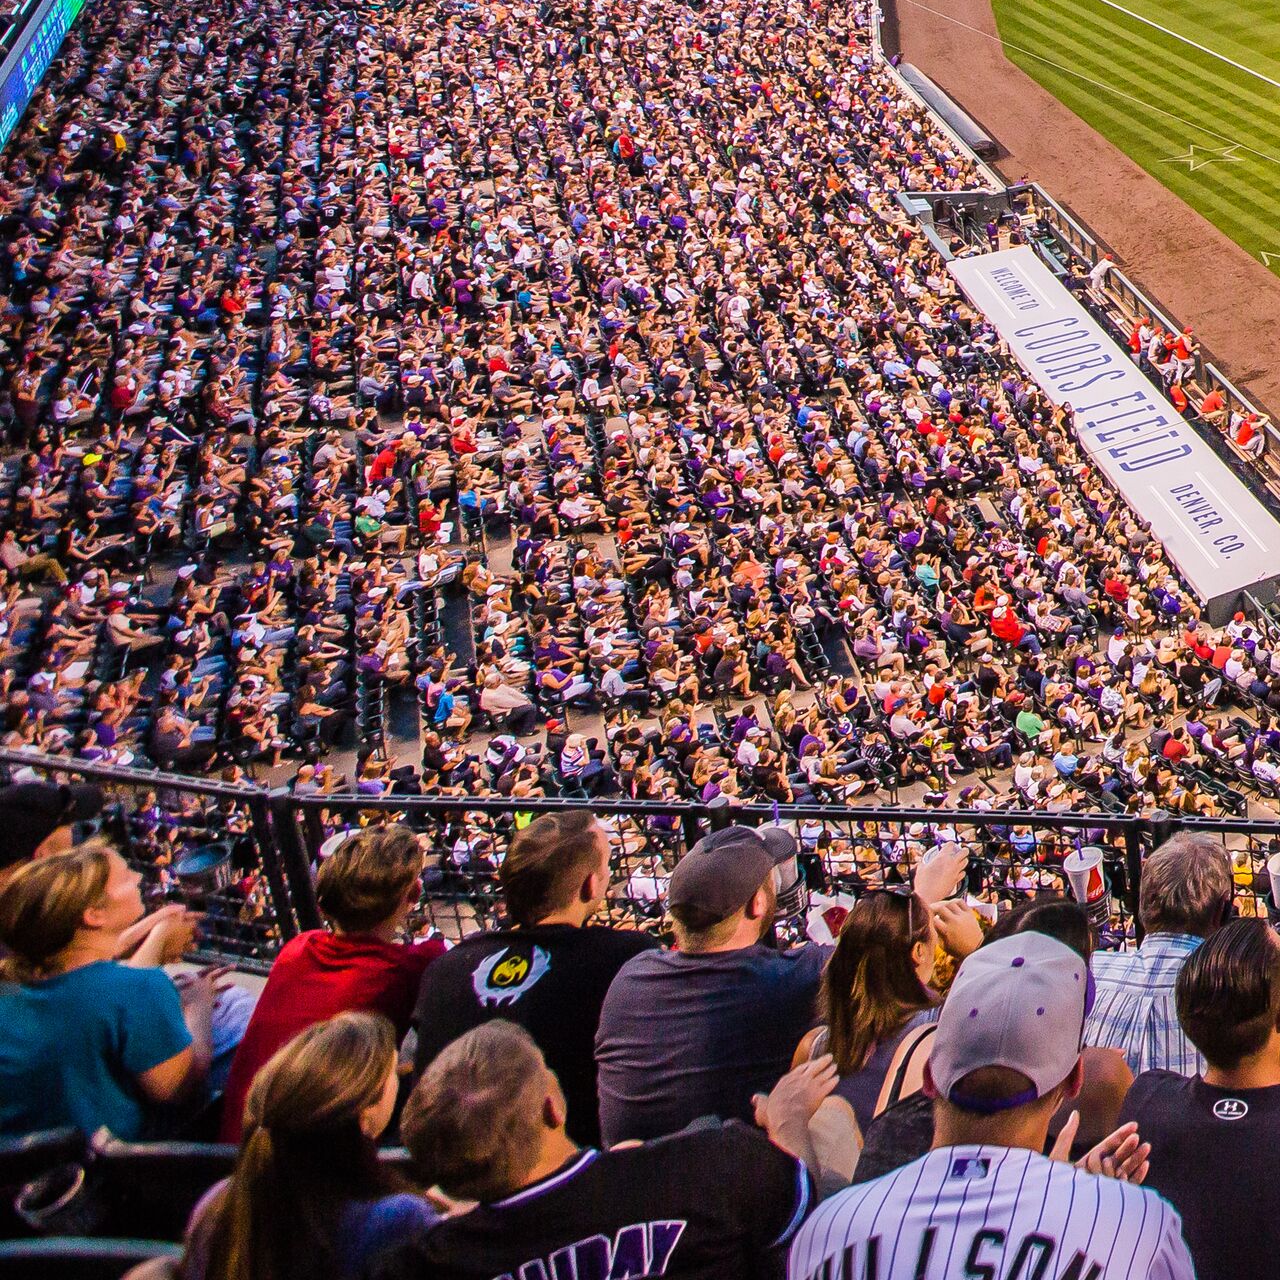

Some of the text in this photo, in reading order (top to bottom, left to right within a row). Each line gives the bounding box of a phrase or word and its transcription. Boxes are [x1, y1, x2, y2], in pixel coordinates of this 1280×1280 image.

[325, 209, 335, 217] 19
[990, 267, 1040, 310] WELCOME TO
[1014, 317, 1194, 473] COORS FIELD
[1169, 483, 1245, 559] DENVER, CO.
